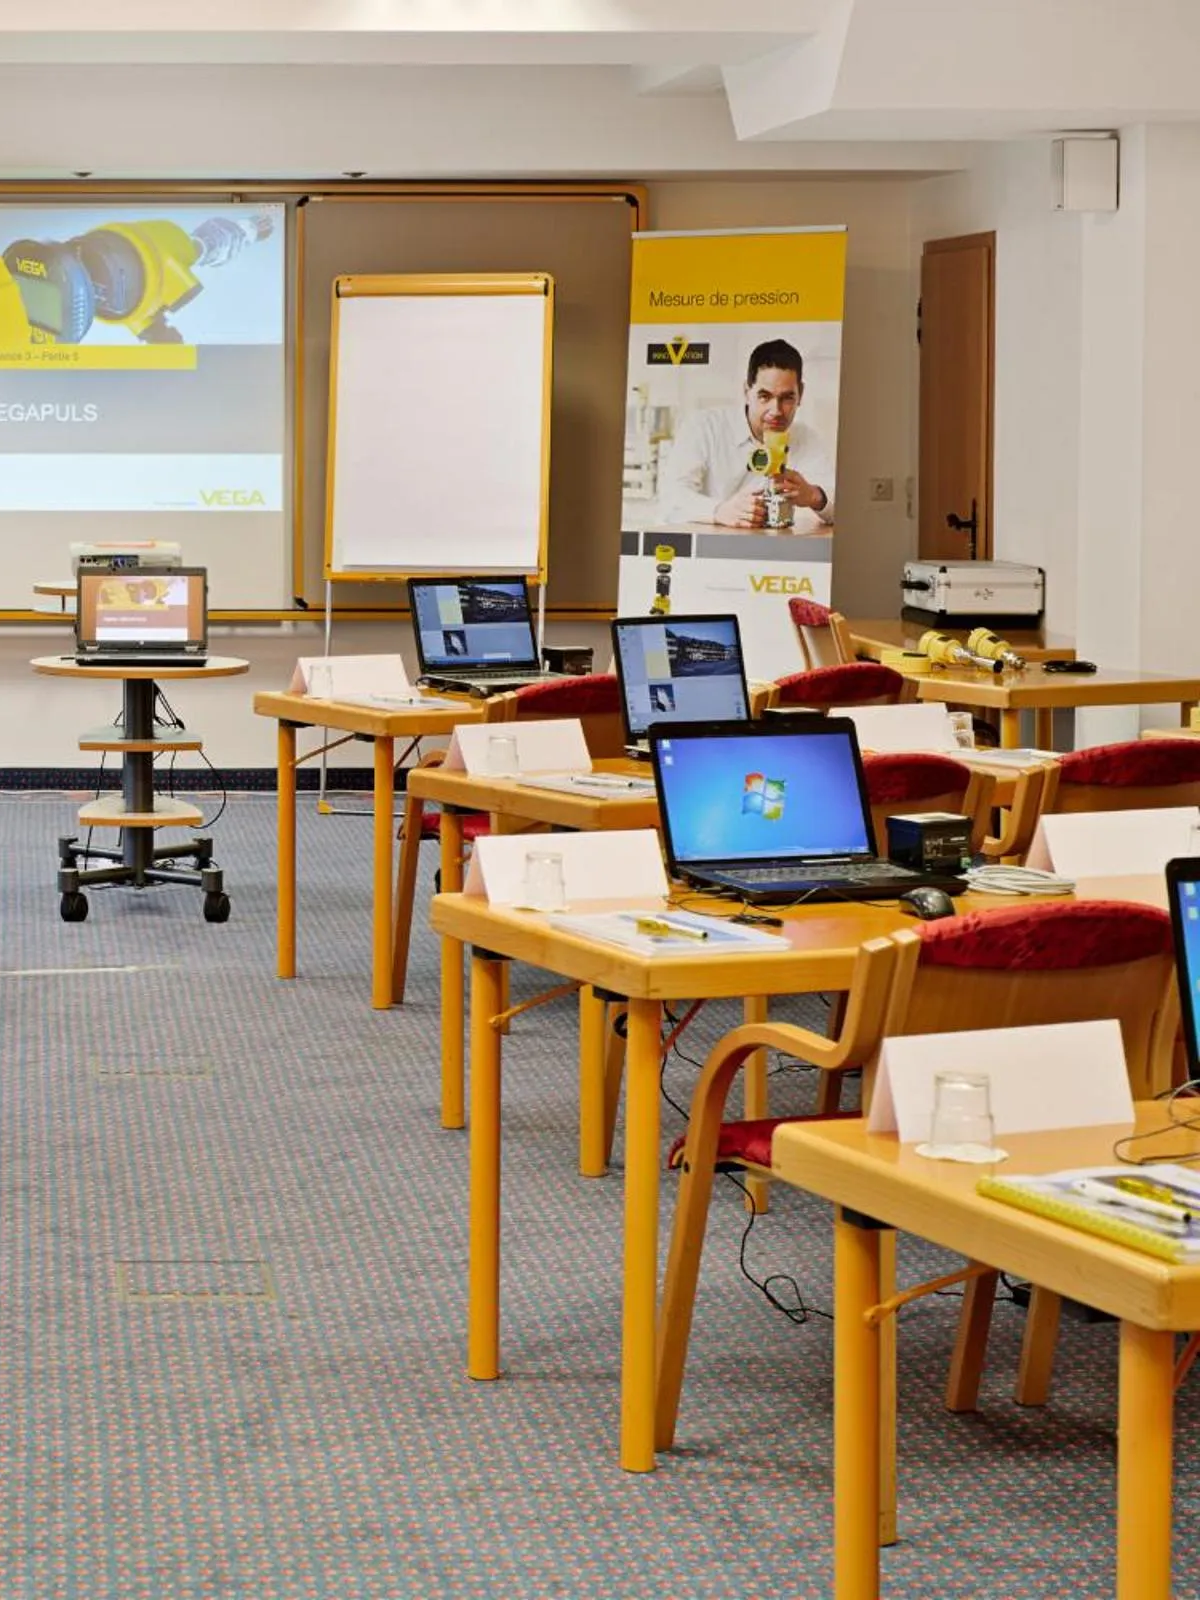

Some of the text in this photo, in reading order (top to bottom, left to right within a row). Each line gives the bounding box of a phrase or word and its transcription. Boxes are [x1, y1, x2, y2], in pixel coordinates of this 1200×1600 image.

[15, 256, 47, 278] VEGA
[649, 289, 800, 308] Mesure de pression
[199, 489, 266, 507] VEGA
[749, 575, 814, 596] VEGA
